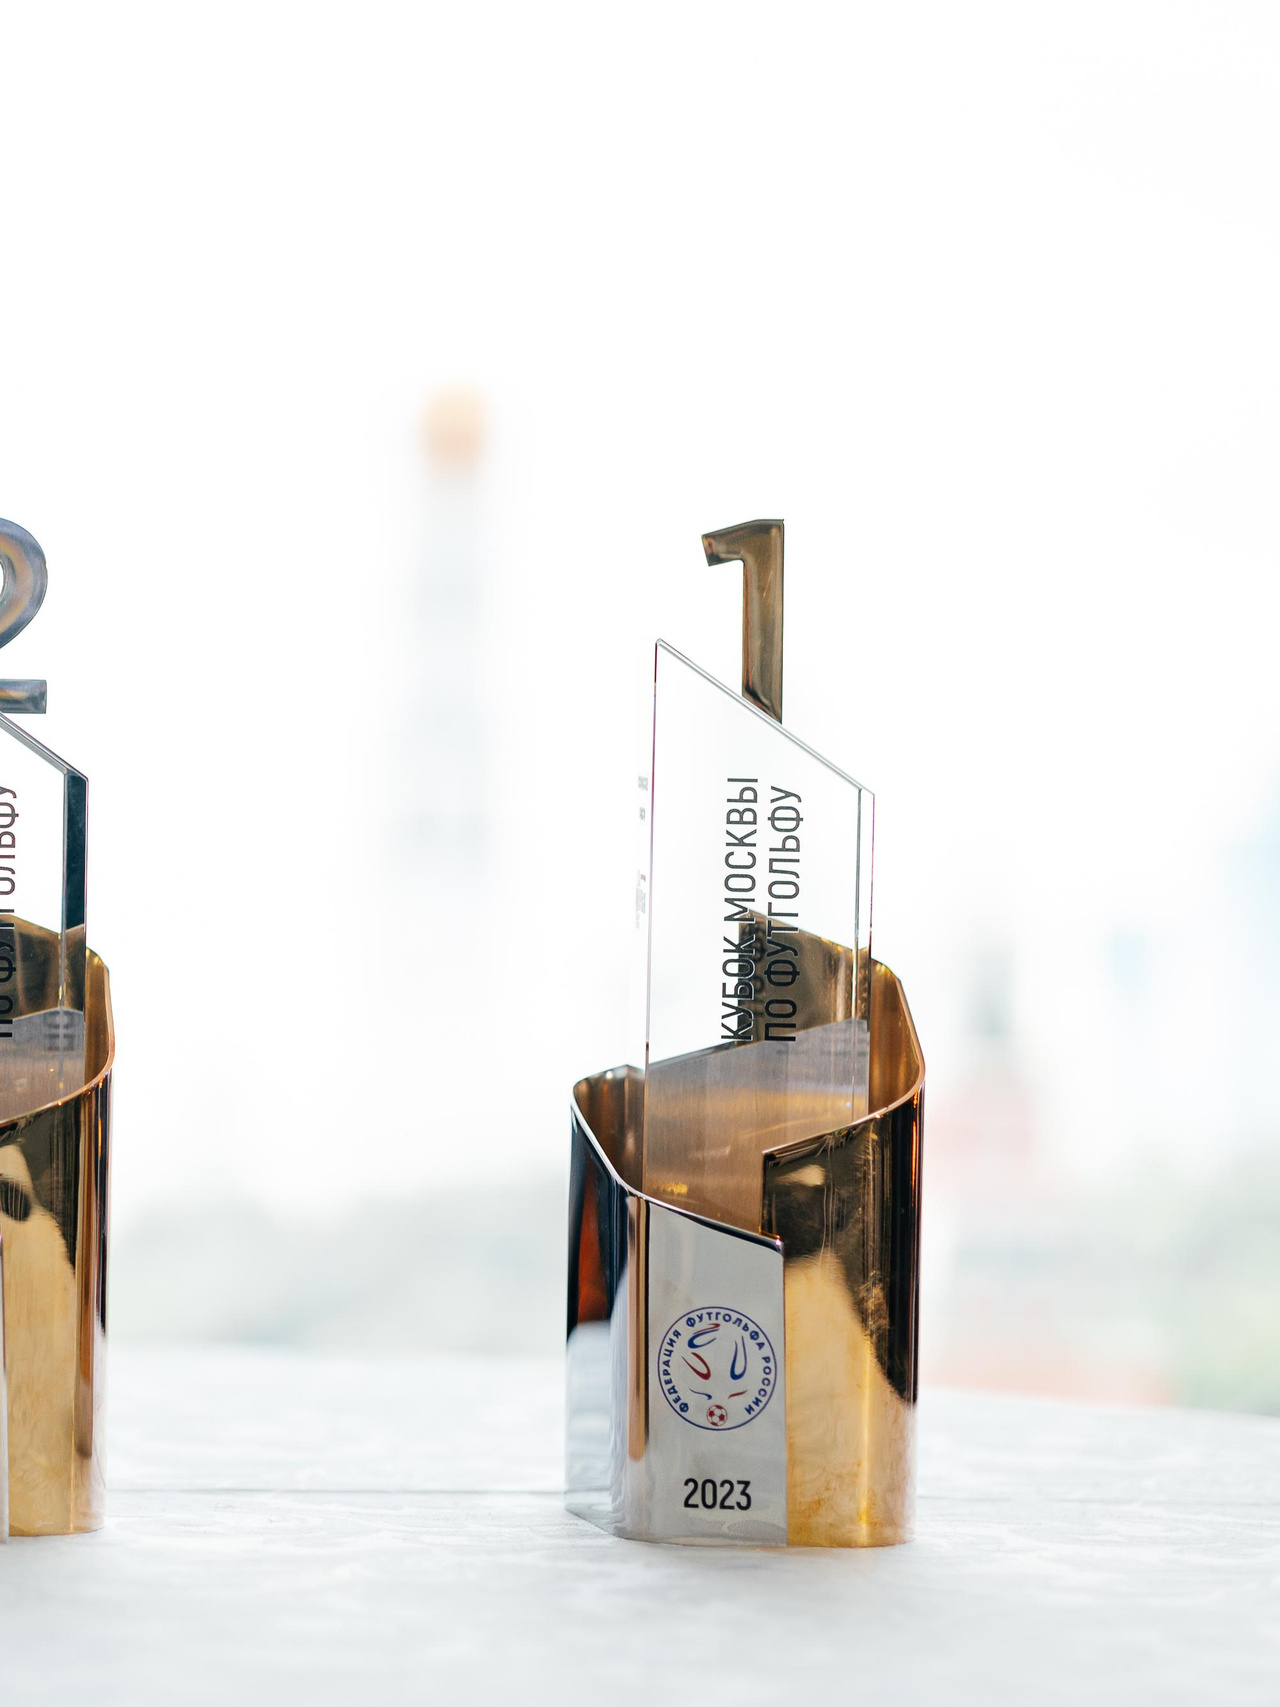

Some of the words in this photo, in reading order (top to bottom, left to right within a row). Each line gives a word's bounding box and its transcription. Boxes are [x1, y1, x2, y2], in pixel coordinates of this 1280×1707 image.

[701, 518, 784, 725] 1
[723, 777, 758, 923] МОСКВЫ
[763, 785, 803, 987] ФУТГОЛЬФУ
[721, 936, 756, 1042] КУБОК
[764, 999, 797, 1042] ПО
[662, 1329, 690, 1414] ФЕДЕРАЦИЯ
[685, 1311, 766, 1351] ФУТГОЛЬФА
[744, 1355, 772, 1416] РОССИИ
[683, 1477, 753, 1512] 2023
